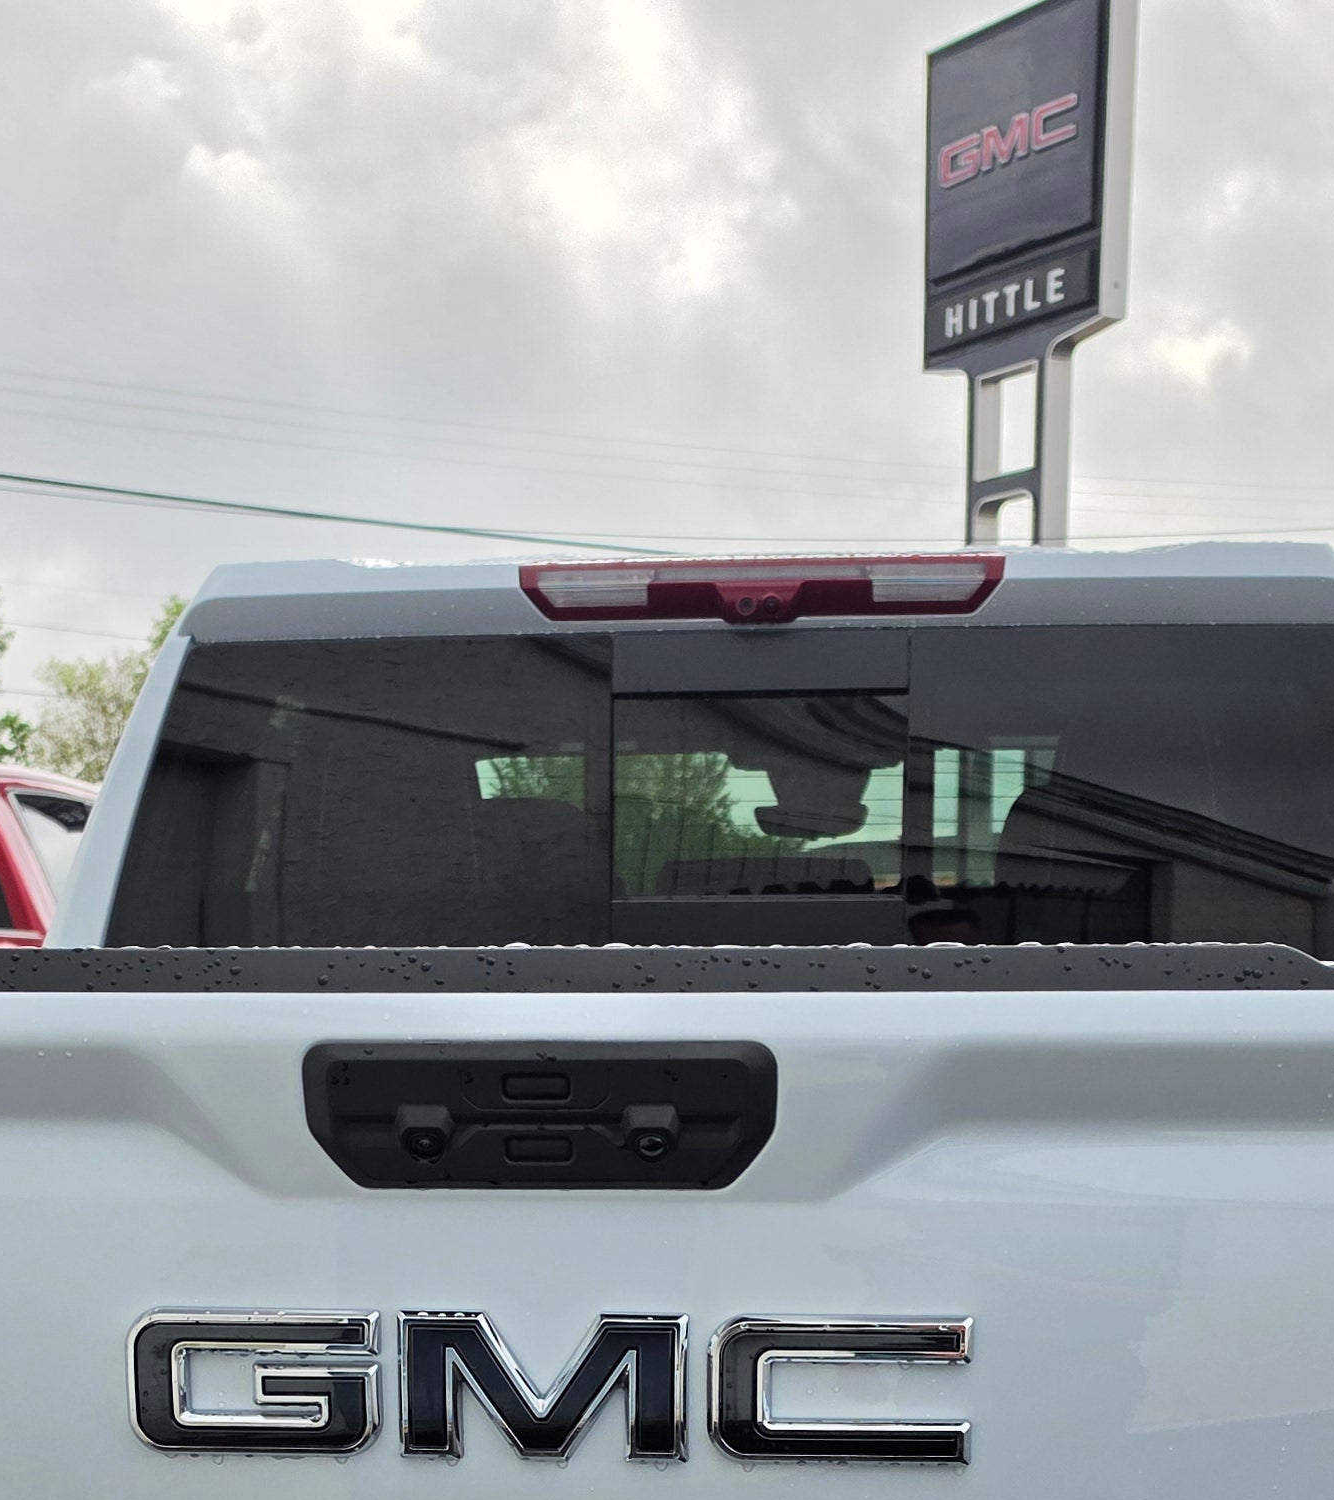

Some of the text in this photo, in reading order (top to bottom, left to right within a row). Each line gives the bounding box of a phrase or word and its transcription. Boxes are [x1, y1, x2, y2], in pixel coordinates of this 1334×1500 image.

[937, 92, 1079, 190] GMC
[943, 267, 1066, 339] HITTLE
[125, 1306, 975, 1468] GMC
